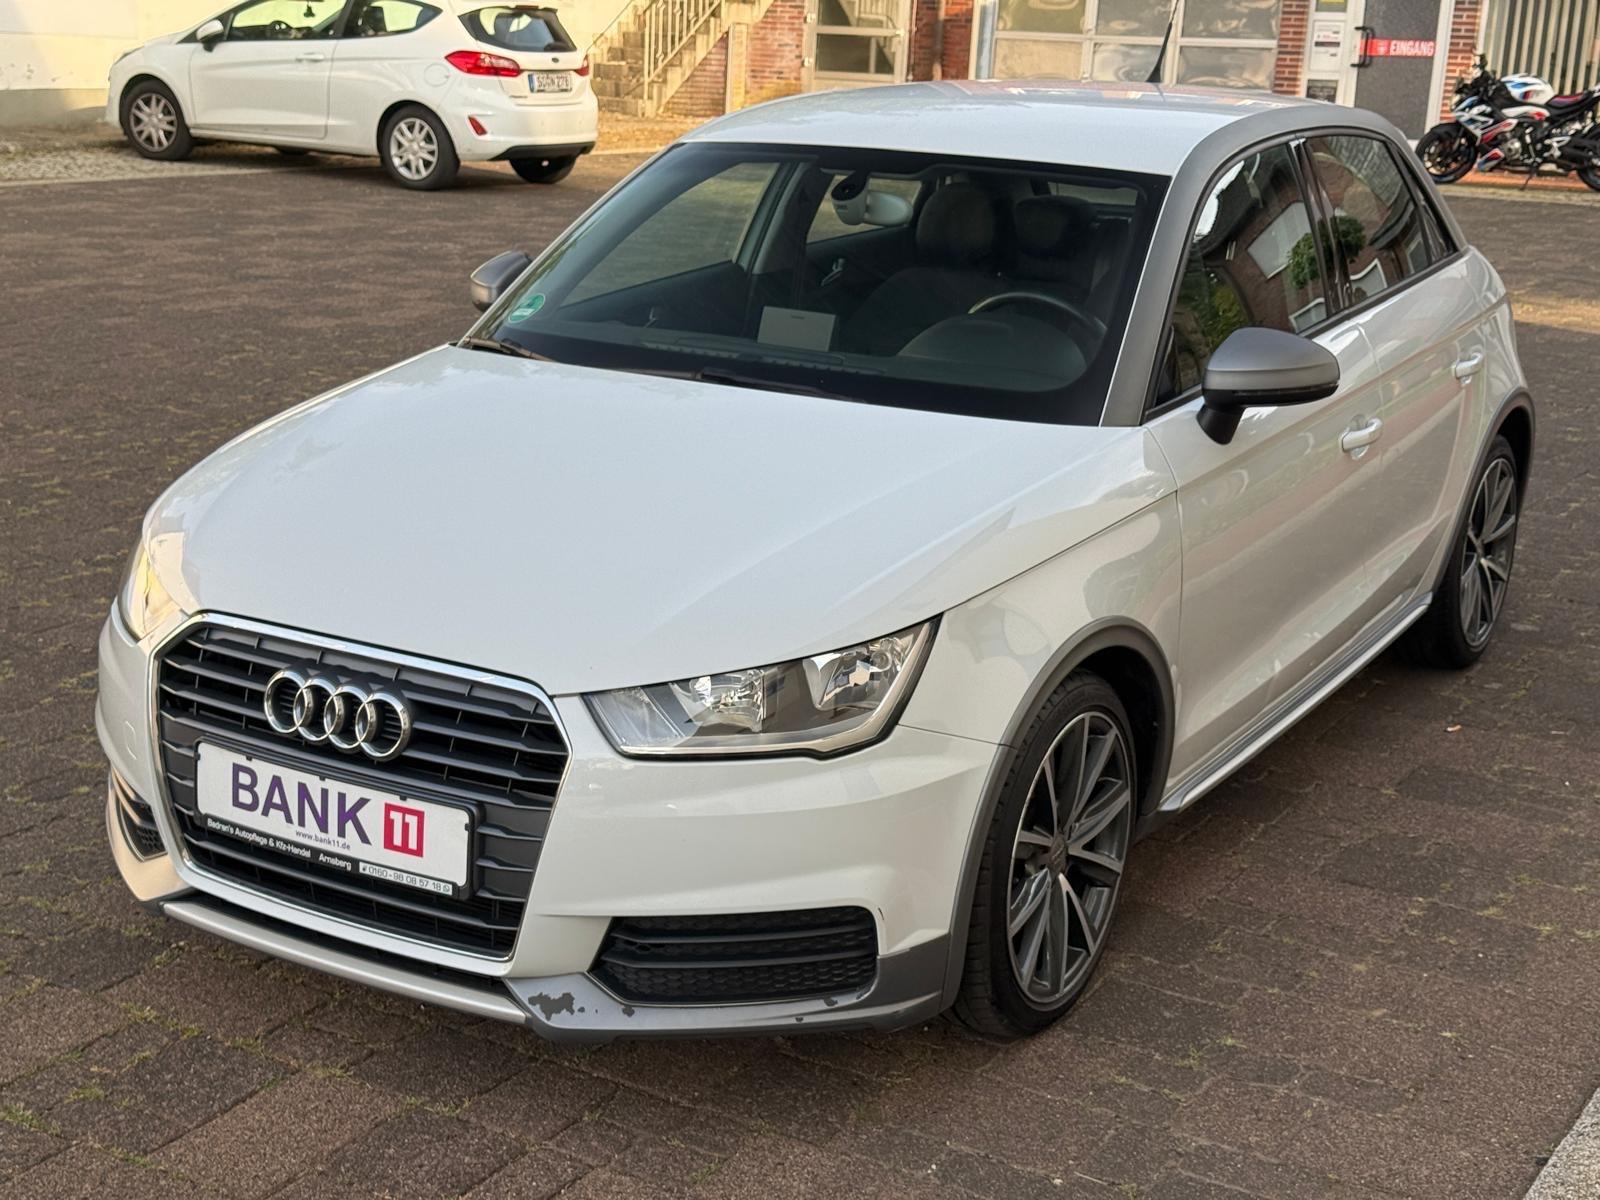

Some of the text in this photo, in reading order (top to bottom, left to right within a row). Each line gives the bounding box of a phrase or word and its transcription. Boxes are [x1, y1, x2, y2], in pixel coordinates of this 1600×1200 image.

[1390, 40, 1435, 56] EINGANG
[232, 762, 418, 850] BANK 11
[234, 826, 267, 846] Autopflege
[268, 838, 275, 847] &
[275, 839, 311, 858] Kfz-Handel
[318, 853, 352, 871] Arnsberg
[295, 829, 351, 850] www.bank11.de
[419, 878, 430, 888] 57
